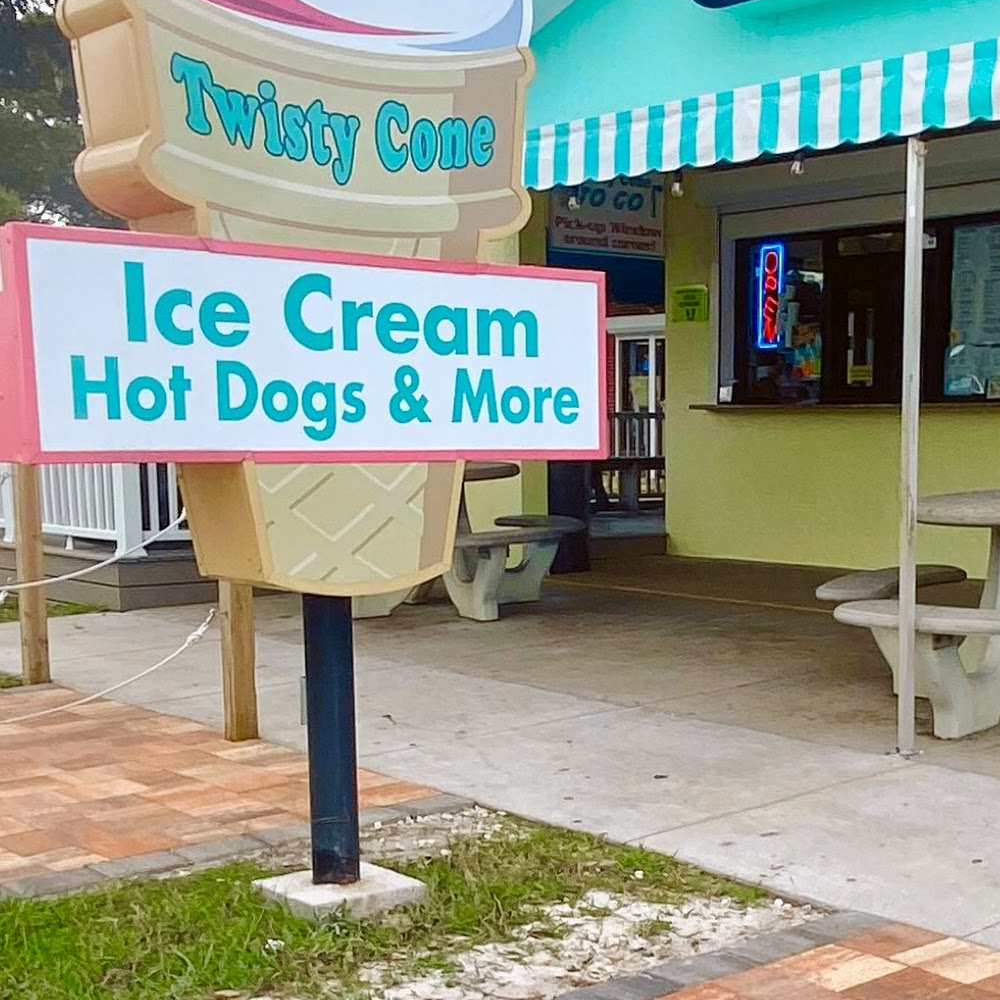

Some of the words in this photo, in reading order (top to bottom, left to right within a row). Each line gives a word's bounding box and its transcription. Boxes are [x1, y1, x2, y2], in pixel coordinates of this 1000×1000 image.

[171, 52, 360, 185] Twisty
[375, 100, 497, 173] Cone
[613, 190, 644, 212] GO
[123, 261, 251, 347] Ice
[284, 273, 538, 358] Cream
[70, 355, 192, 421] Hot
[216, 360, 365, 441] Dogs
[389, 365, 431, 423] &
[452, 368, 579, 425] More
